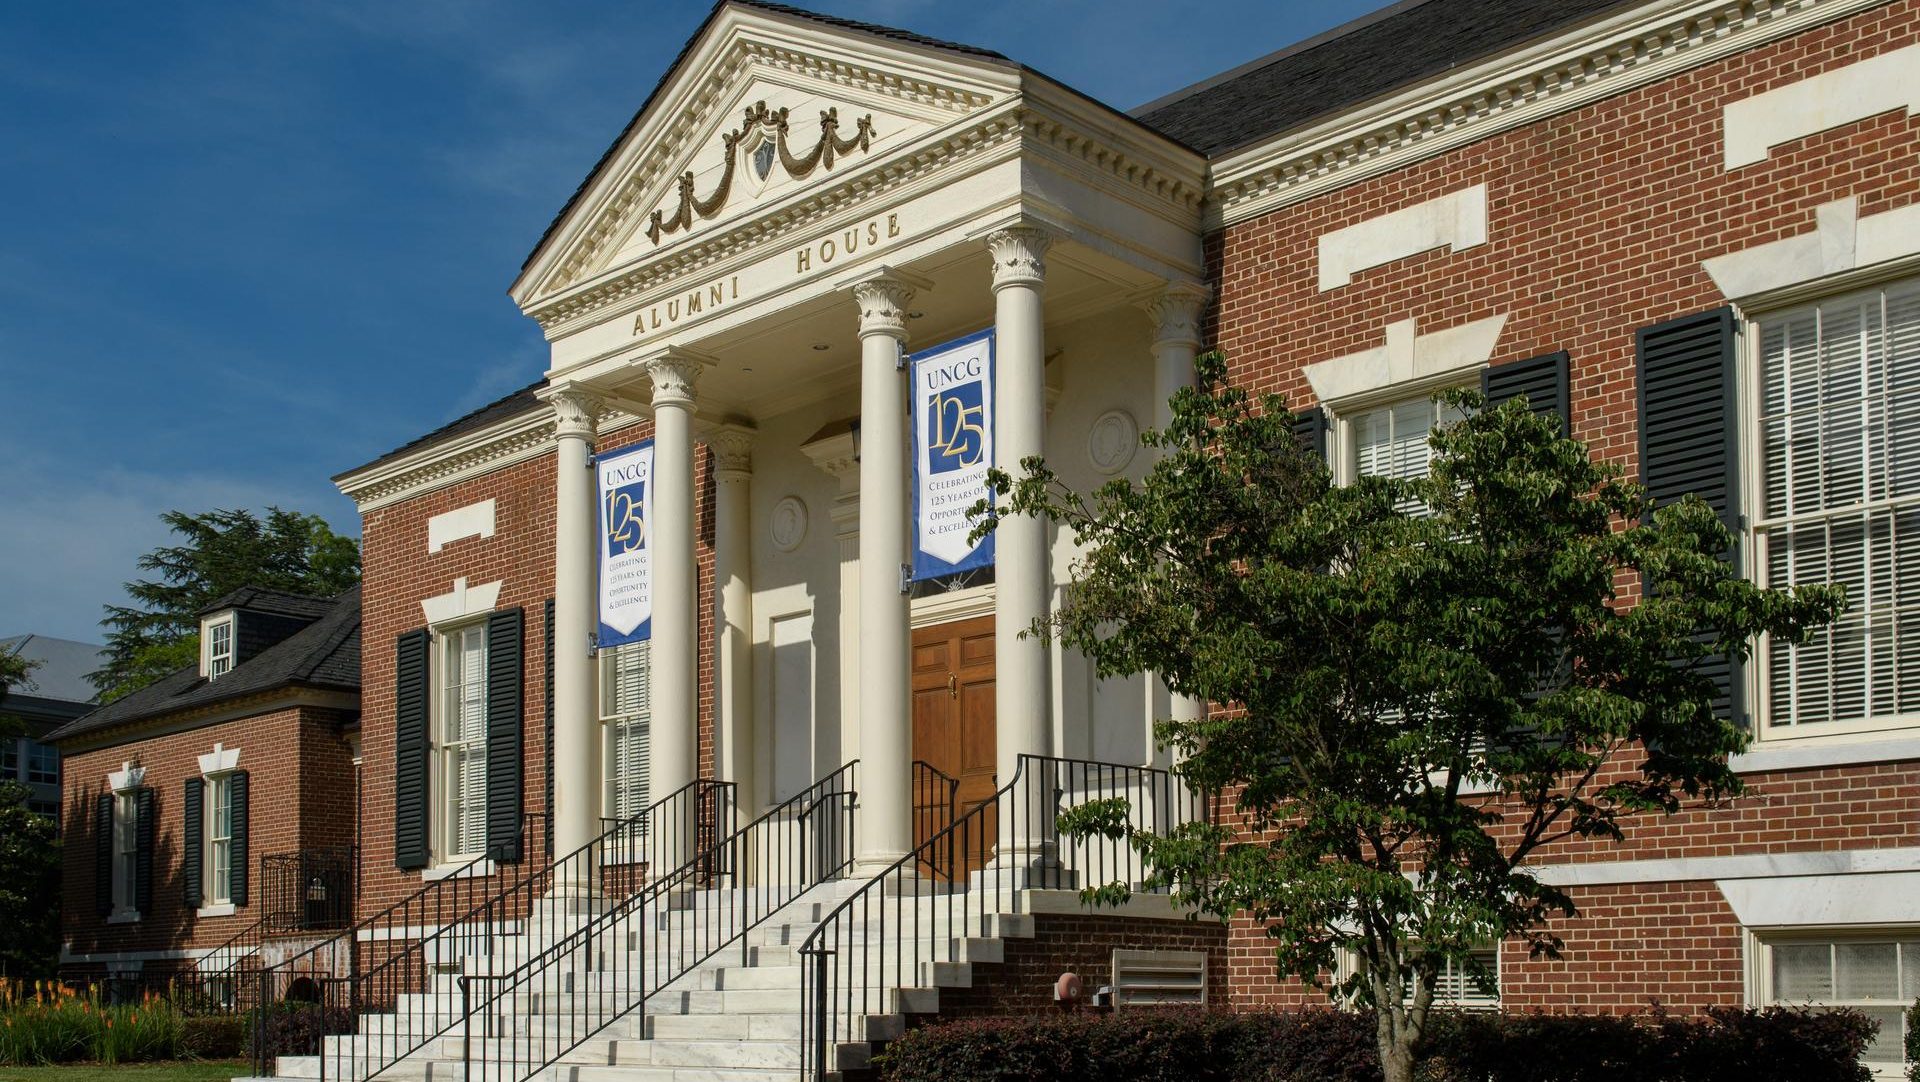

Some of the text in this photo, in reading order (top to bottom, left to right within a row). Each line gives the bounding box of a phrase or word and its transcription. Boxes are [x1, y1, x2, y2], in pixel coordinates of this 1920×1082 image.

[632, 212, 900, 336] ALUMNI HOUSE
[927, 357, 981, 389] UNCG
[928, 393, 984, 467] 125
[607, 461, 646, 486] UNCG
[929, 470, 984, 491] CELEBRATING
[931, 486, 984, 506] 125 YEARS OF
[605, 489, 644, 553] 125
[930, 504, 977, 520] OPPORTU
[928, 525, 936, 535] &
[636, 569, 647, 577] OF
[608, 601, 614, 610] &
